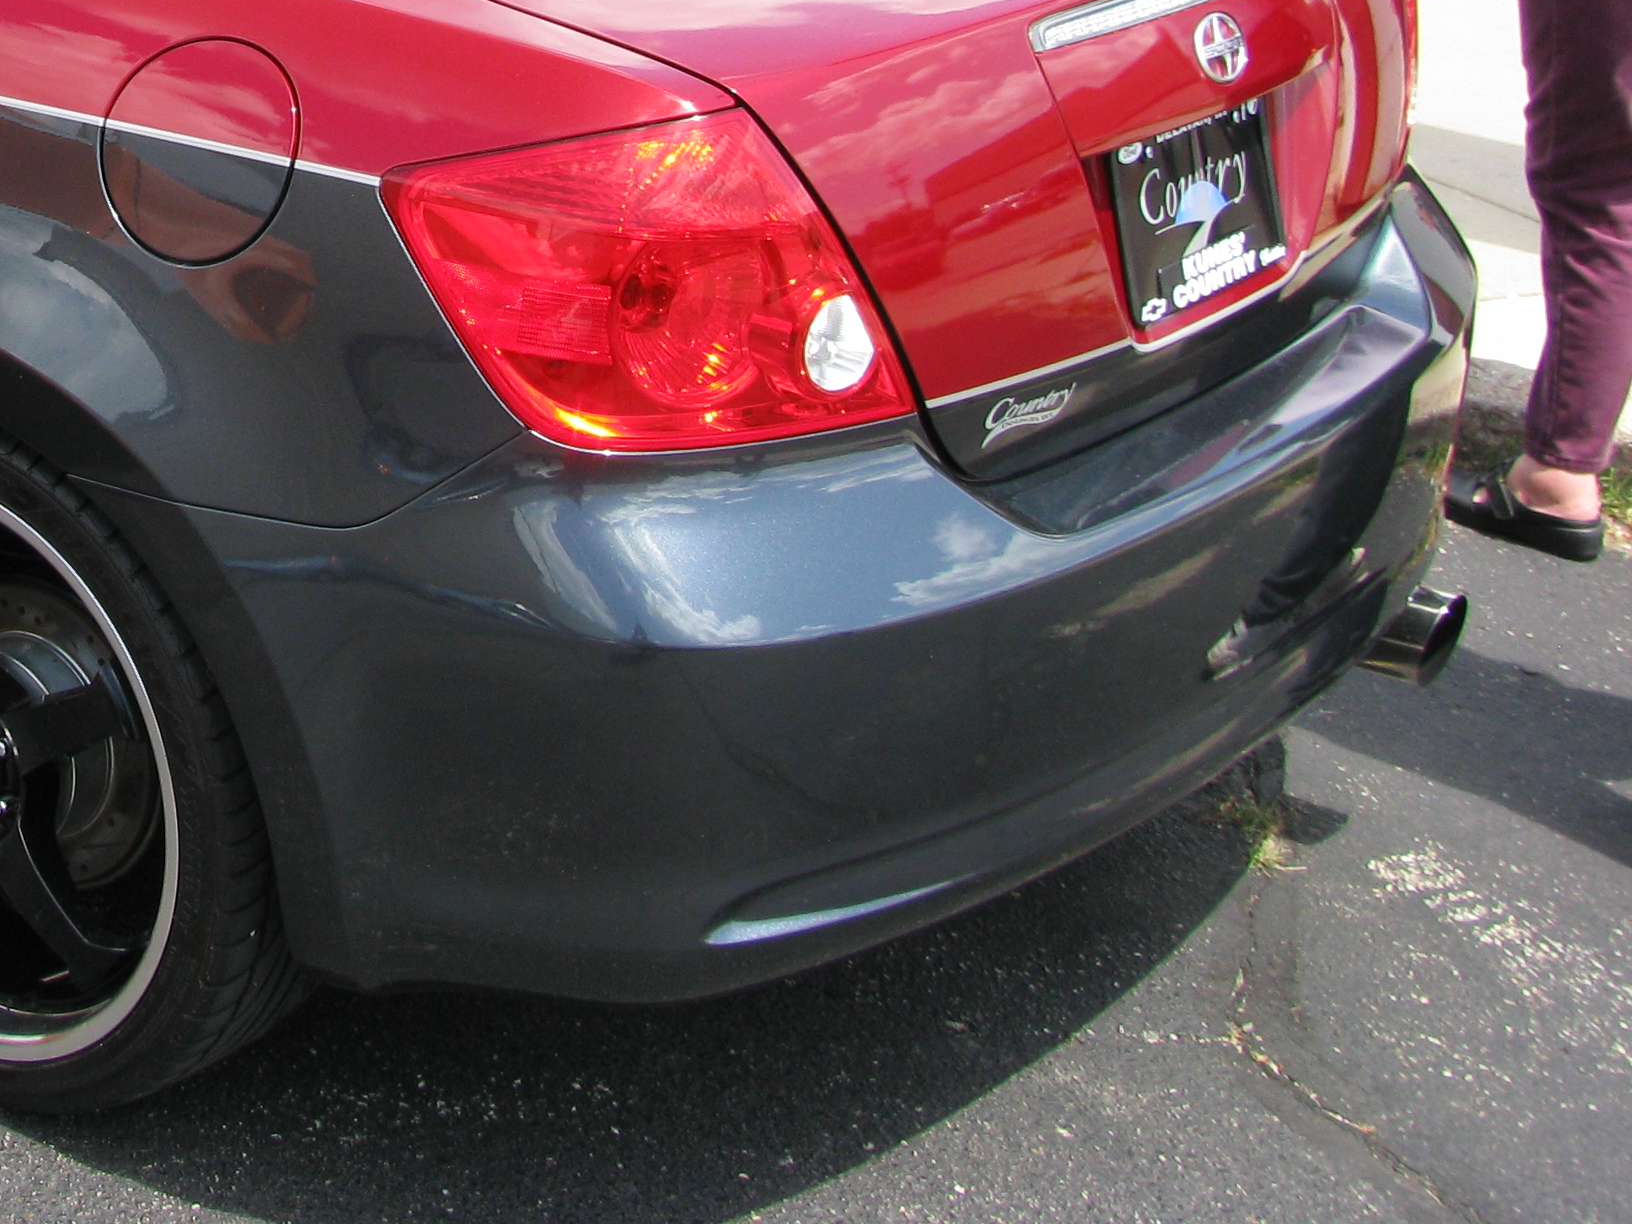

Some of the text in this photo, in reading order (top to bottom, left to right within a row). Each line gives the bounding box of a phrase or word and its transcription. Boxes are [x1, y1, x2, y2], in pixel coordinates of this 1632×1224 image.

[1140, 151, 1246, 225] Country
[1172, 249, 1257, 308] COUNTRY
[984, 381, 1077, 430] Country
